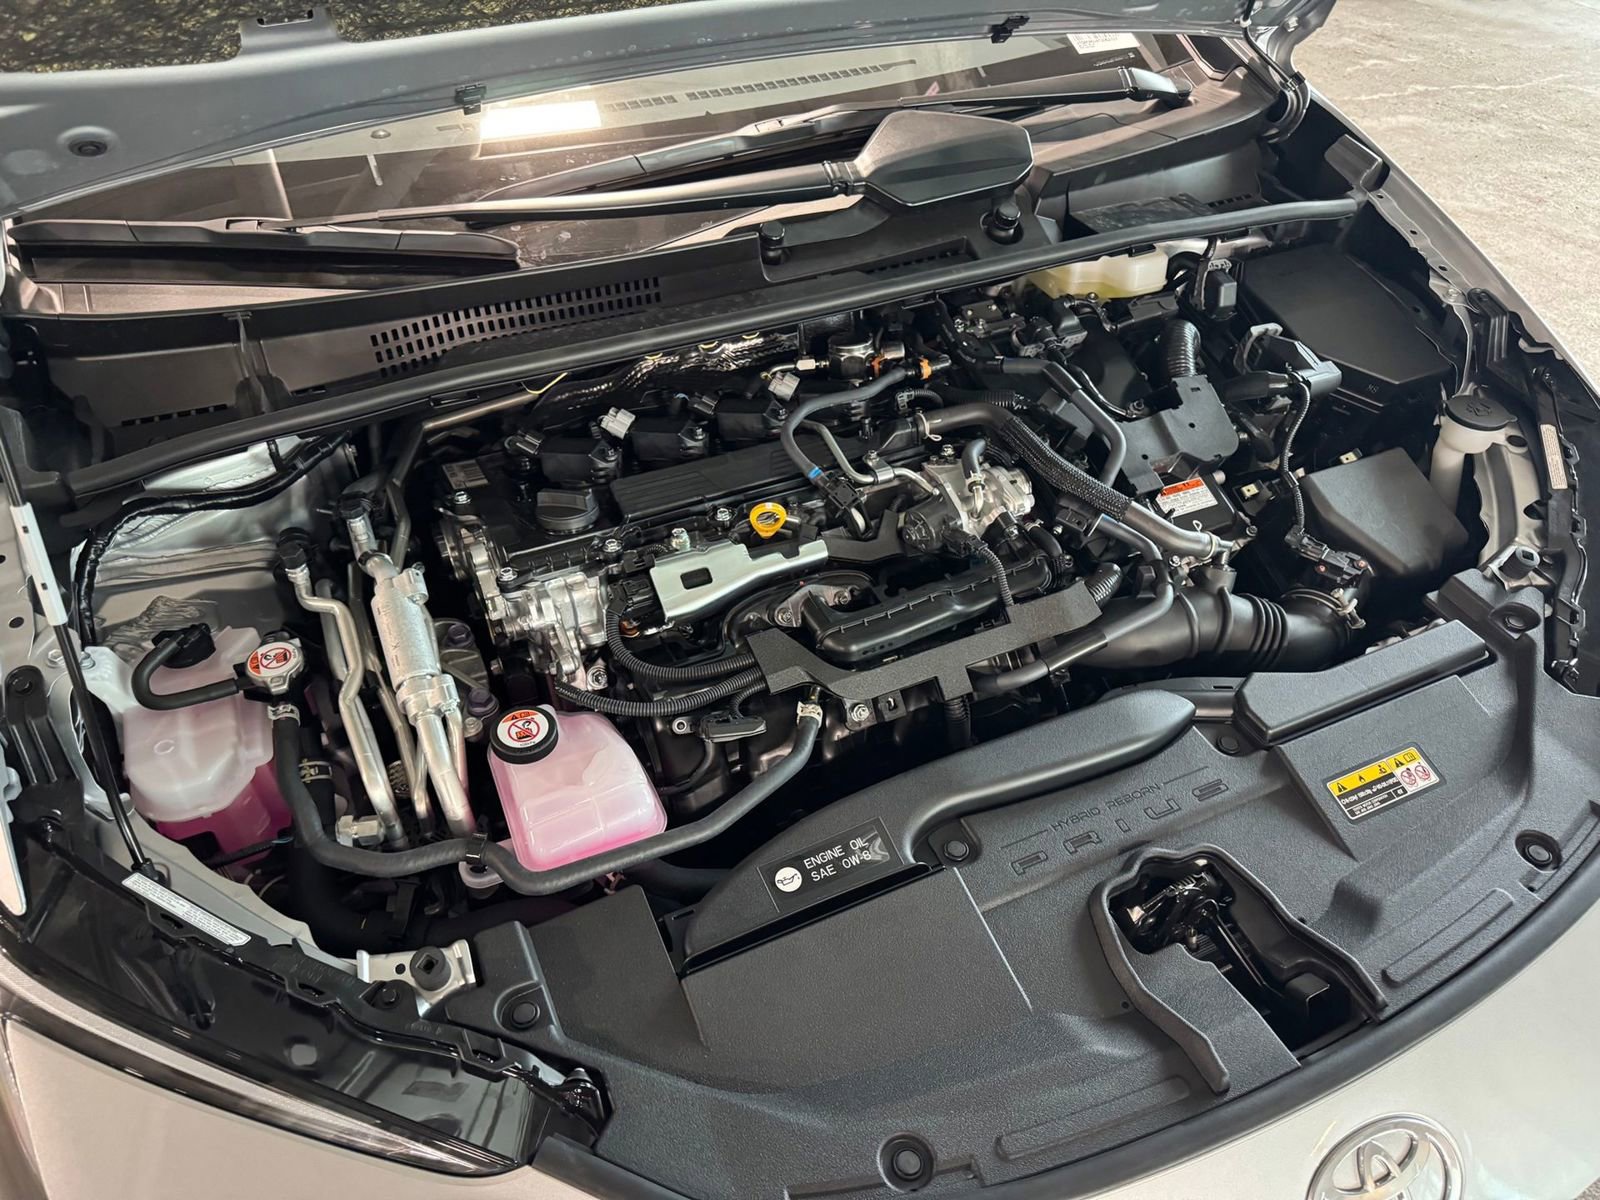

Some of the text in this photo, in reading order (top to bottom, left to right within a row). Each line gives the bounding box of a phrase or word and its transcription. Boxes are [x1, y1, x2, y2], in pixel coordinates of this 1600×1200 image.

[1010, 778, 1229, 876] PRIUS
[1051, 782, 1163, 832] HYBRID REBORN
[803, 837, 869, 869] ENGINE OIL
[811, 850, 872, 882] SAE 0W-8
